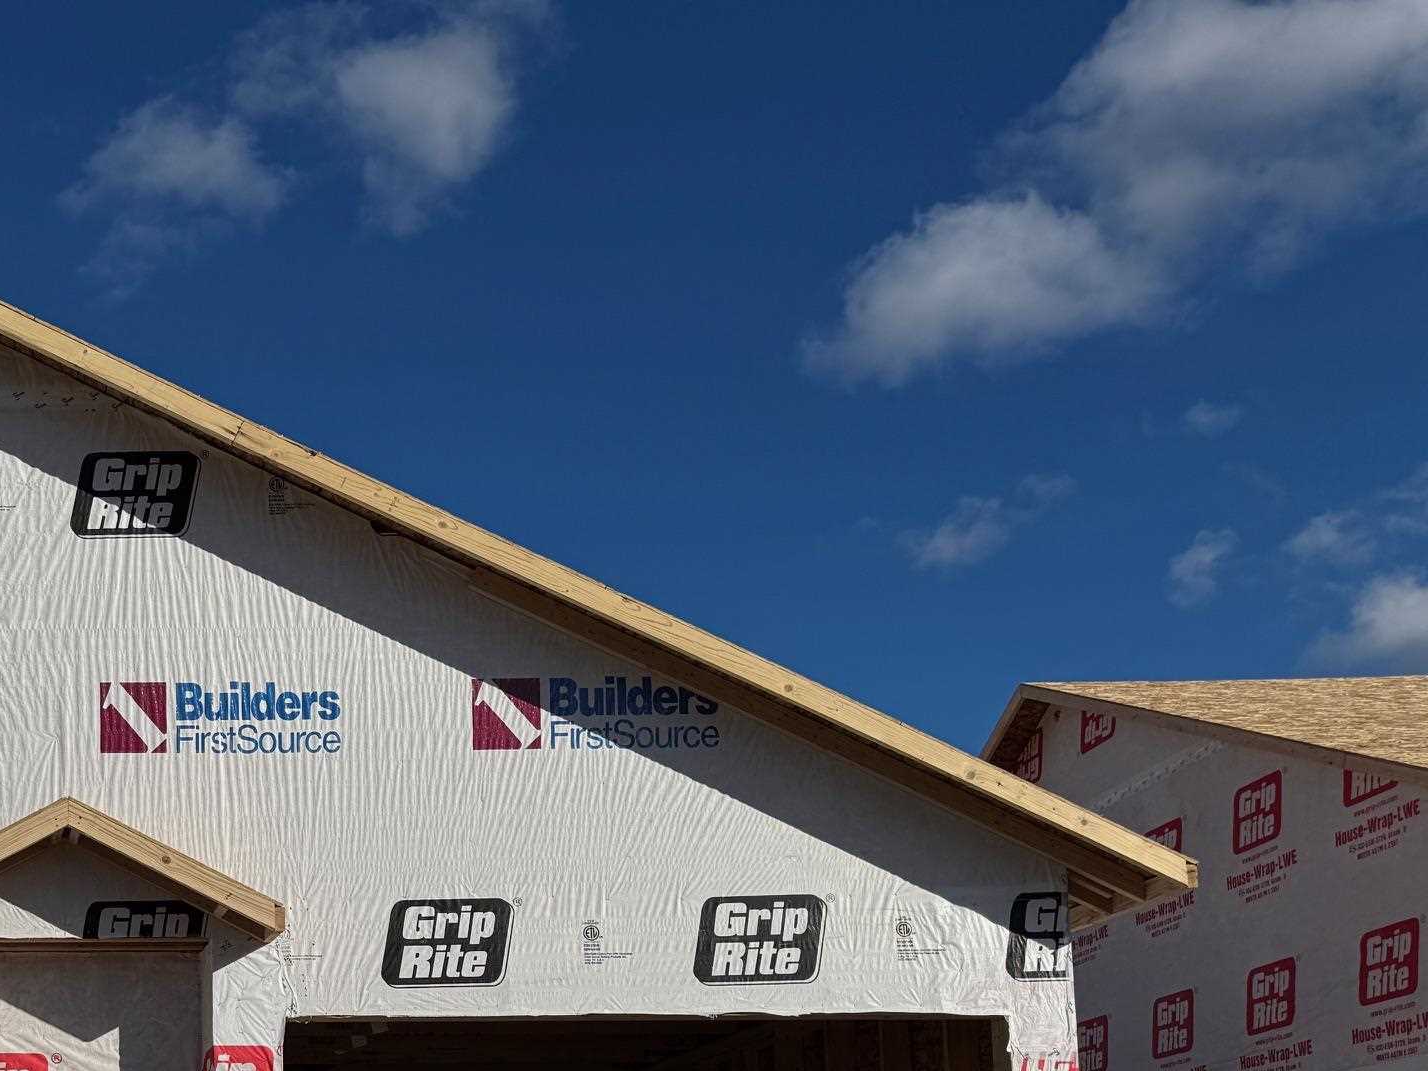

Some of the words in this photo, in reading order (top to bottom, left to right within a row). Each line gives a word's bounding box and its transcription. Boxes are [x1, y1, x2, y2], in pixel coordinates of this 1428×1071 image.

[92, 457, 182, 496] Grip
[87, 495, 173, 530] Rite
[175, 681, 341, 721] Builders
[549, 676, 719, 716] Builders
[175, 725, 341, 754] FirstSource
[550, 720, 720, 749] FirstSource
[1239, 782, 1276, 818] Grip
[1240, 813, 1274, 847] Rite
[1335, 798, 1420, 847] House-Wrap-LWE
[1227, 850, 1297, 890] House-Wrap-LWE
[99, 907, 189, 938] Grip
[402, 905, 495, 944] Grip
[714, 902, 808, 941] Grip
[399, 945, 488, 978] Rite
[711, 943, 801, 976] Rite
[1366, 929, 1412, 966] Grip
[1252, 967, 1289, 999] Grip
[1367, 964, 1410, 1000] Rite
[1156, 997, 1189, 1027] Grip
[1253, 999, 1288, 1029] Rite
[1157, 1026, 1188, 1054] Rite
[1239, 1040, 1313, 1071] House-Wrap-LWE
